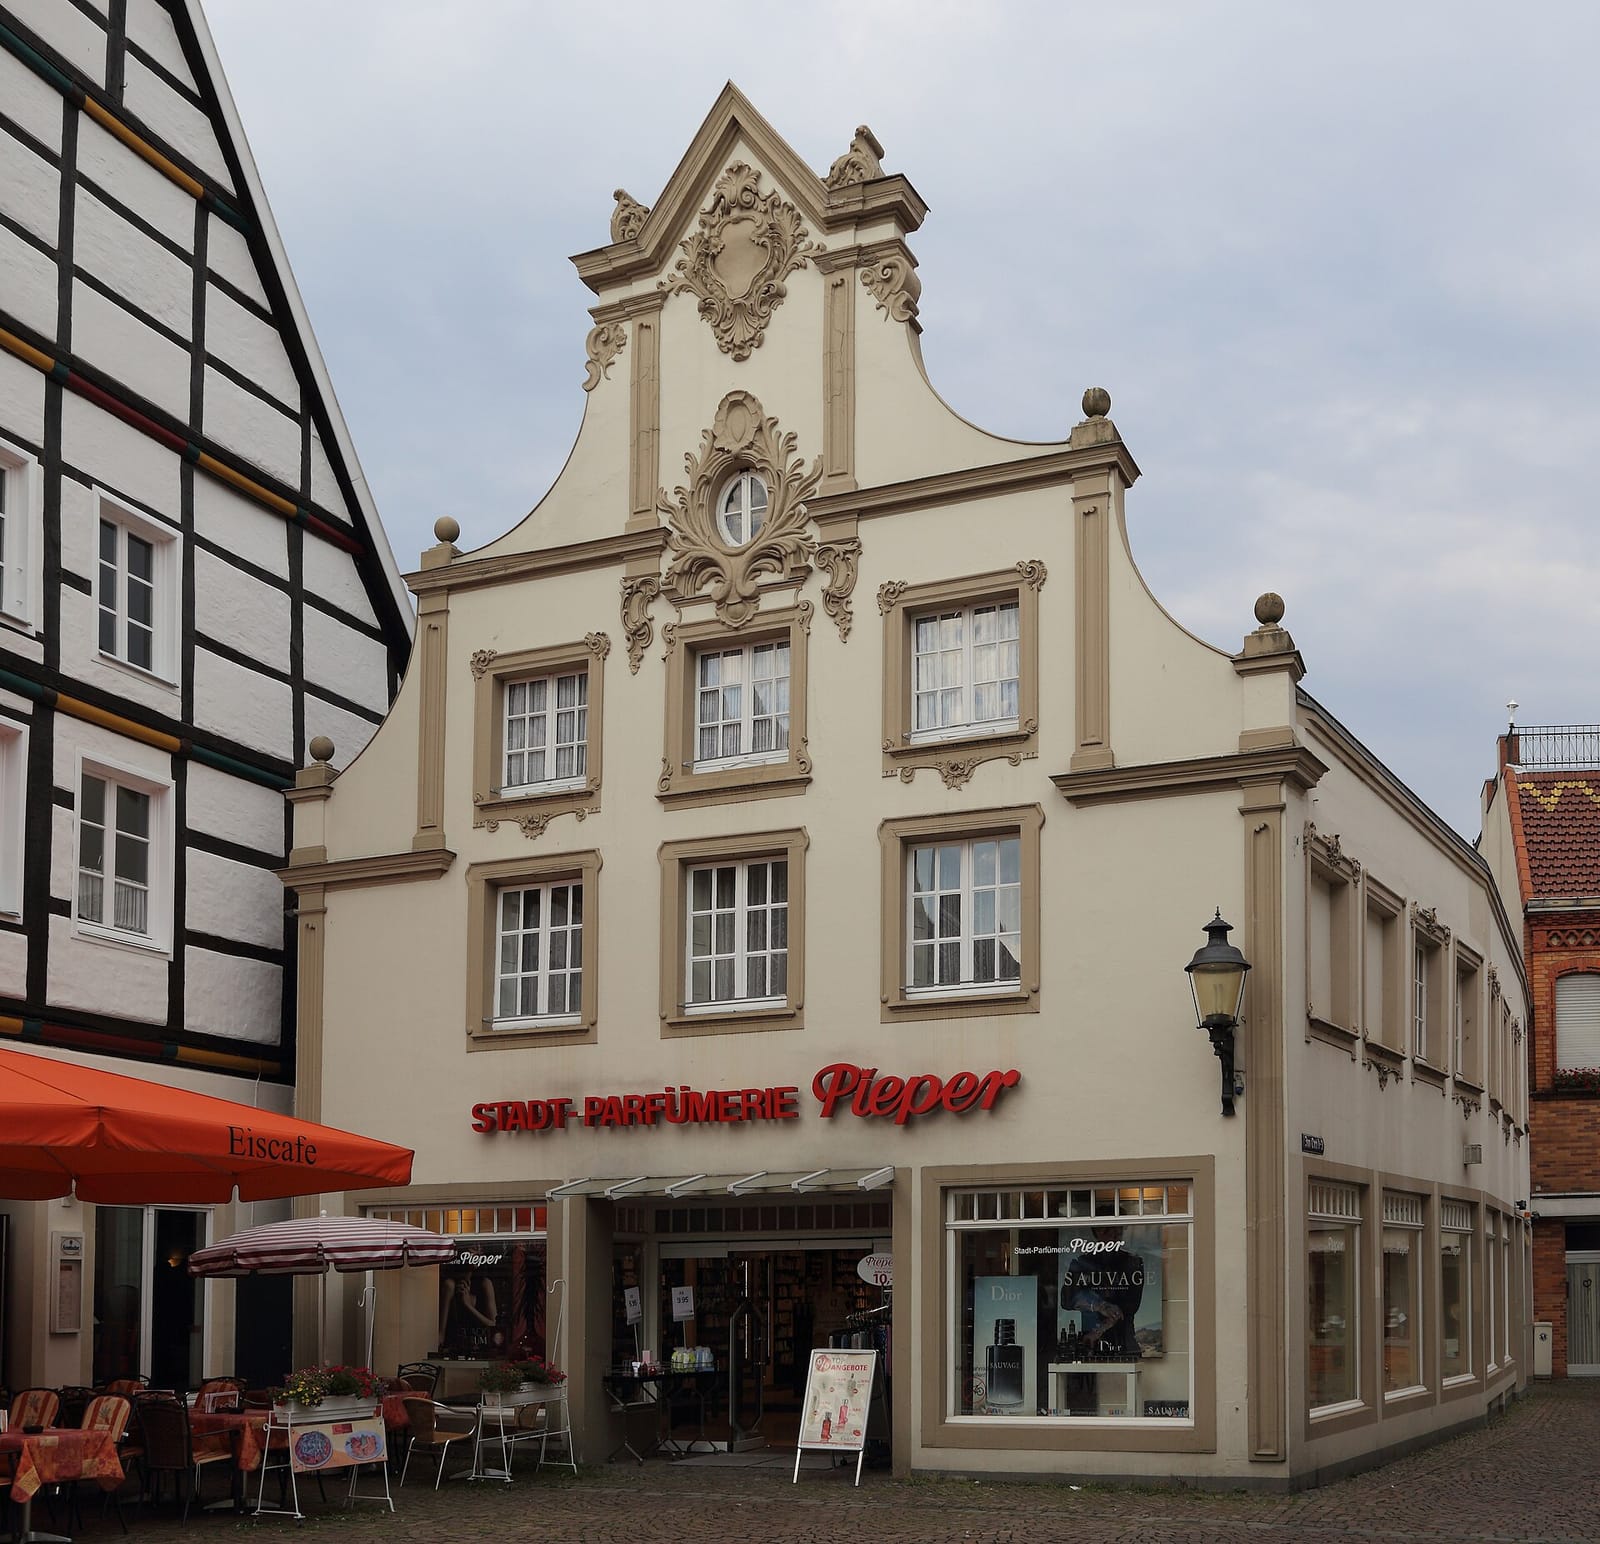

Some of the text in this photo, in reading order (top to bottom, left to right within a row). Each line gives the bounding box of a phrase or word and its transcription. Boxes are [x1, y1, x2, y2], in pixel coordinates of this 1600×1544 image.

[812, 1063, 1021, 1125] Pieper
[226, 1125, 317, 1165] Eiscafe
[1070, 1237, 1125, 1256] Pieper
[460, 1251, 503, 1268] Pieper
[866, 1256, 894, 1268] Piepe
[1063, 1270, 1157, 1287] SAUVAGE
[991, 1285, 1023, 1301] Dior
[1097, 1340, 1122, 1352] Dior
